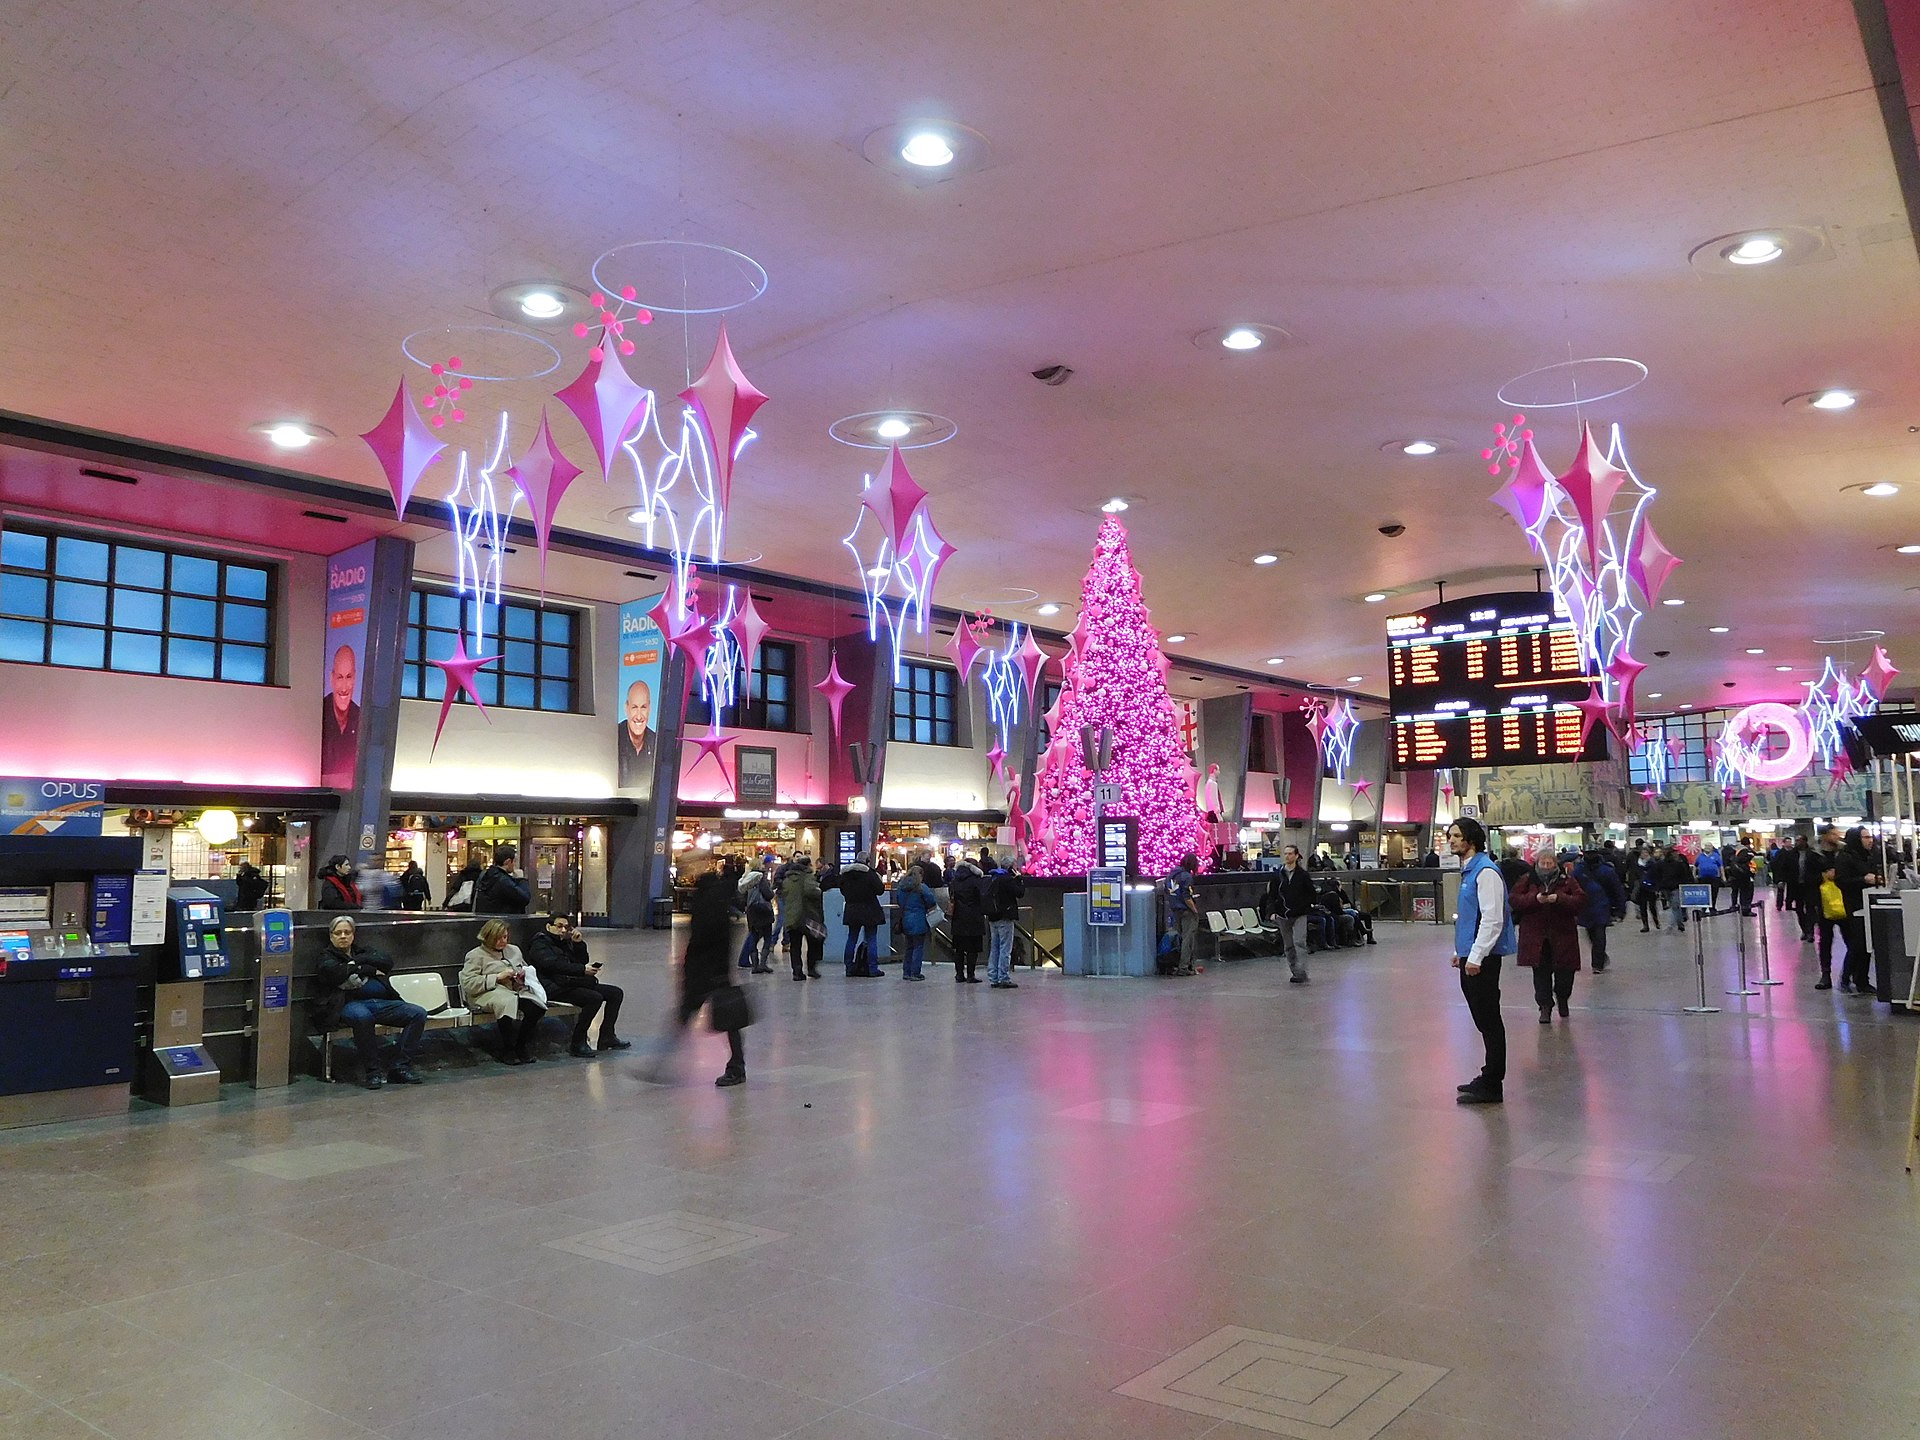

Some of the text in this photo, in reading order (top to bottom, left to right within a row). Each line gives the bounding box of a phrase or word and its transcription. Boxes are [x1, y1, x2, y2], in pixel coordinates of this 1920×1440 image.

[330, 566, 366, 590] RADIO
[623, 616, 659, 633] RADIO
[754, 774, 770, 786] Gare
[41, 781, 101, 799] OPUS
[1100, 788, 1112, 800] 11
[1463, 807, 1473, 815] 13
[1271, 814, 1279, 822] 14
